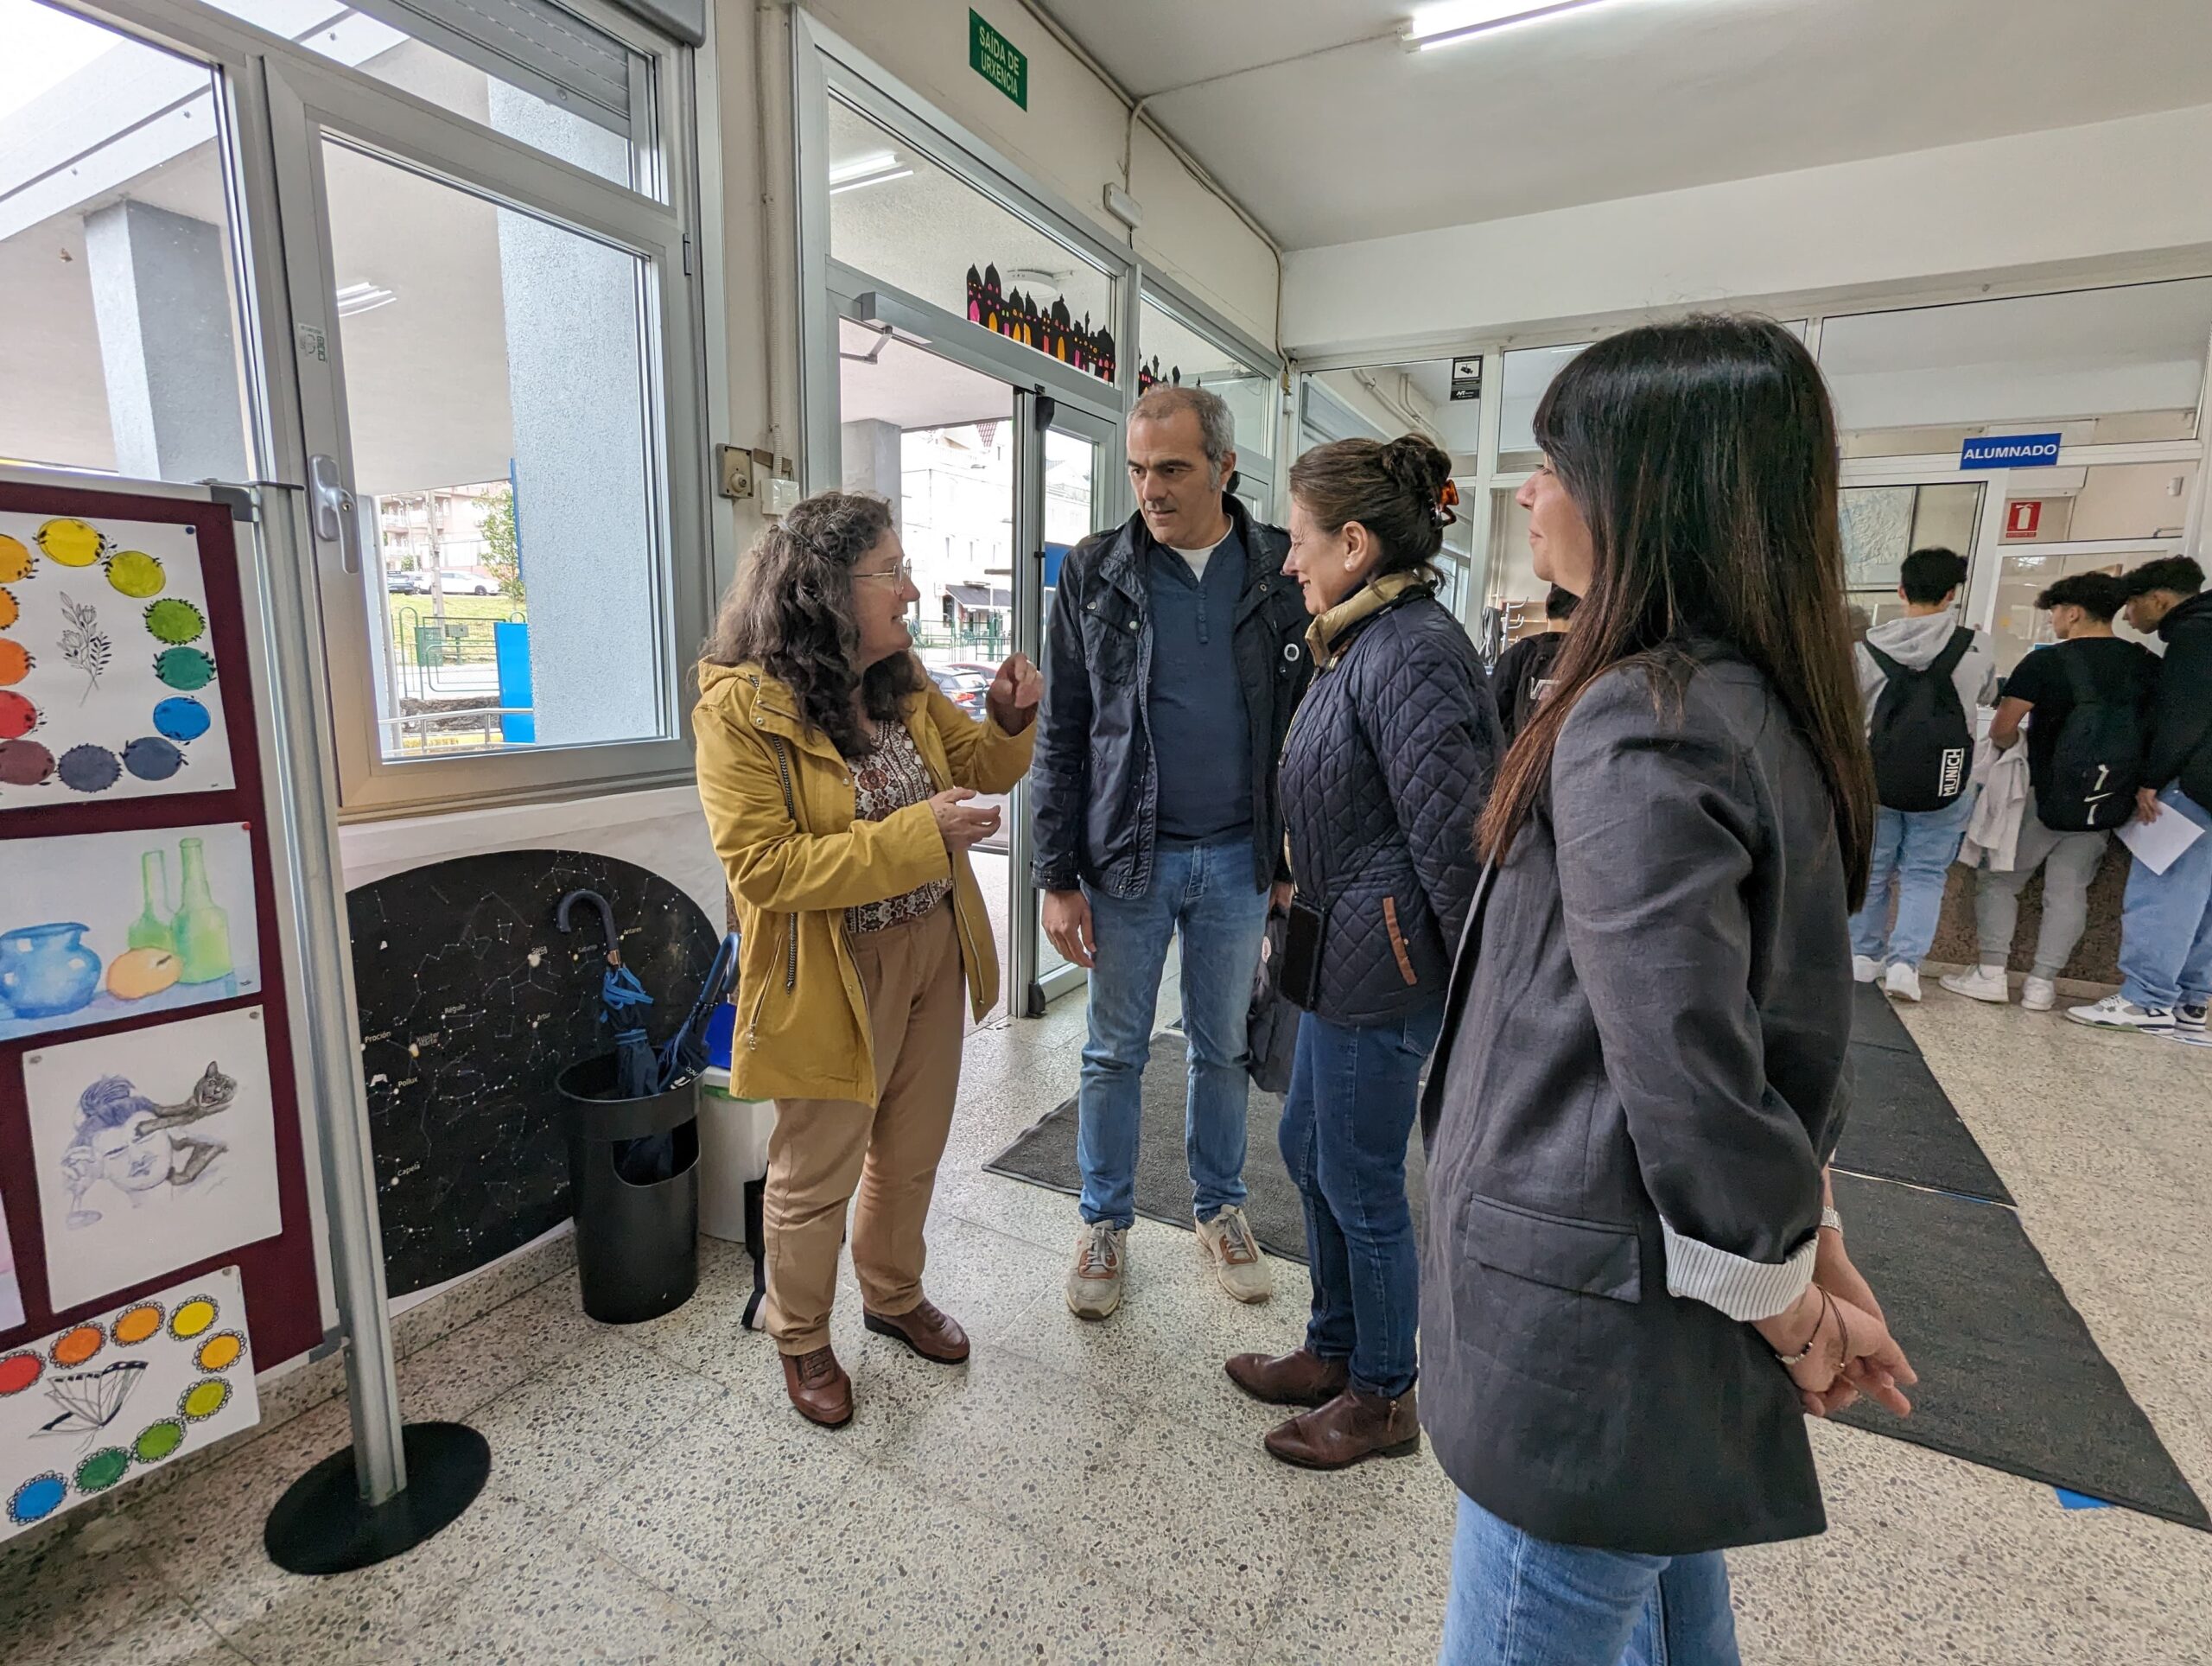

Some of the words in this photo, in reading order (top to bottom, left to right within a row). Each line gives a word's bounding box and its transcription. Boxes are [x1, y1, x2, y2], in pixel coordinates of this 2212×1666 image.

[979, 25, 1006, 65] SAÍDA
[1007, 50, 1020, 76] DE
[981, 50, 1018, 99] URXENCIA
[1963, 443, 2056, 460] ALUMNADO
[1943, 748, 1961, 797] MUNICH
[365, 1031, 391, 1044] Proción
[397, 1077, 418, 1088] Pollux
